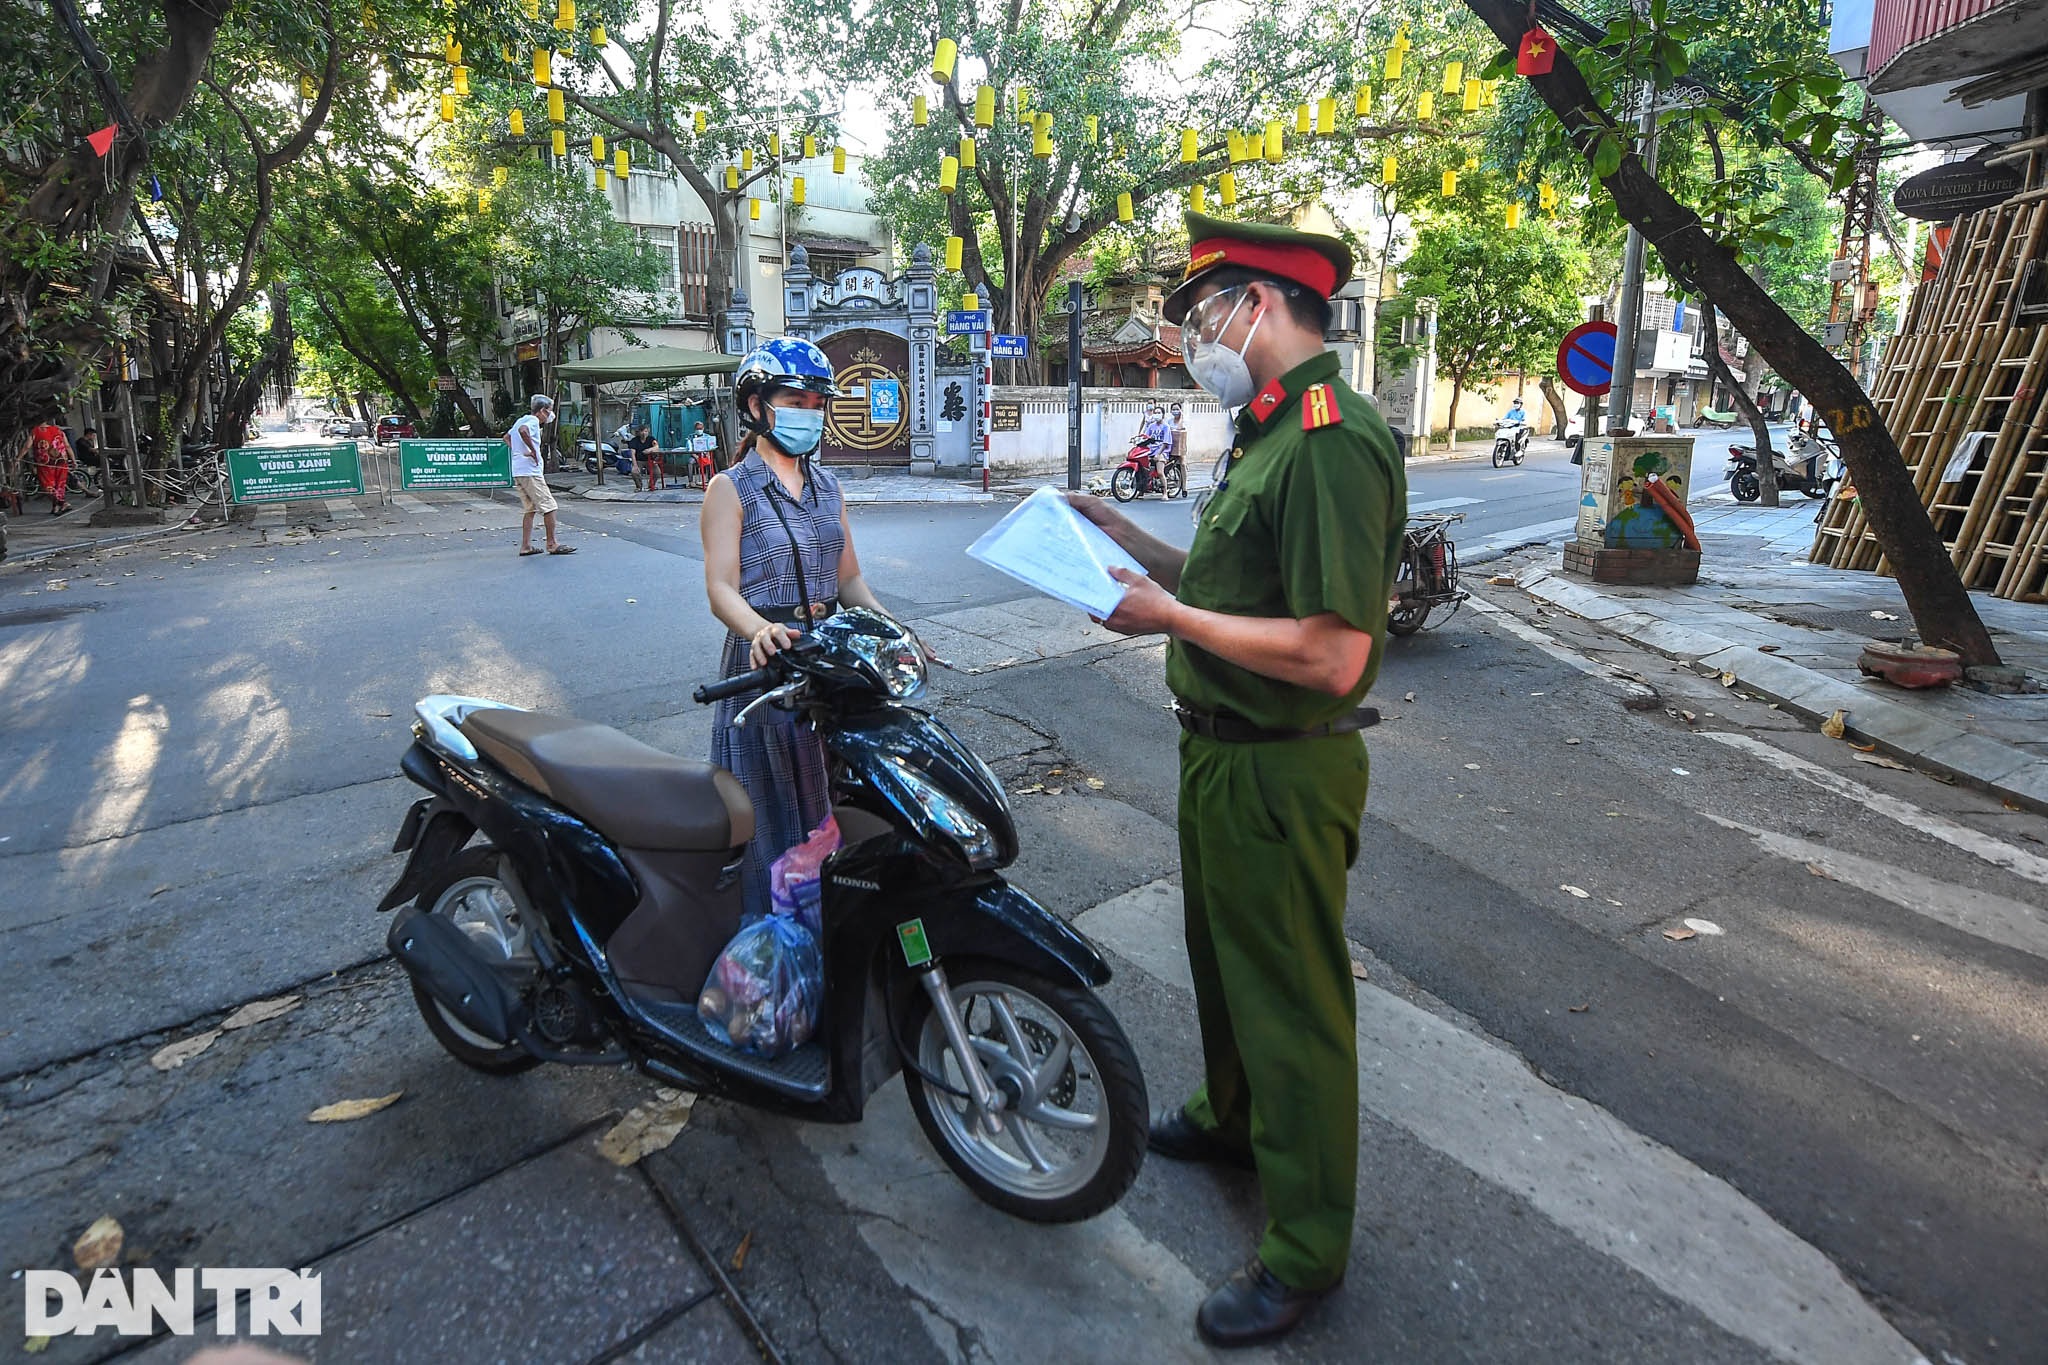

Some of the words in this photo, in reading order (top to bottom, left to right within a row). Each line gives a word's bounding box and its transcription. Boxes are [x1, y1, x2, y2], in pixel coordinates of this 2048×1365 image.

[1899, 187, 1927, 199] NOVA
[1931, 183, 1974, 197] LUXURY
[1978, 179, 2015, 192] HOTEL
[949, 321, 970, 331] HÀNG
[972, 319, 984, 330] VẢI
[993, 345, 1012, 355] HÀNG
[1014, 345, 1023, 355] GÀ
[426, 453, 456, 462] VÙNG
[458, 453, 487, 461] XANH
[260, 460, 294, 471] VÙNG
[298, 458, 331, 469] XANH
[833, 875, 880, 890] HONDA
